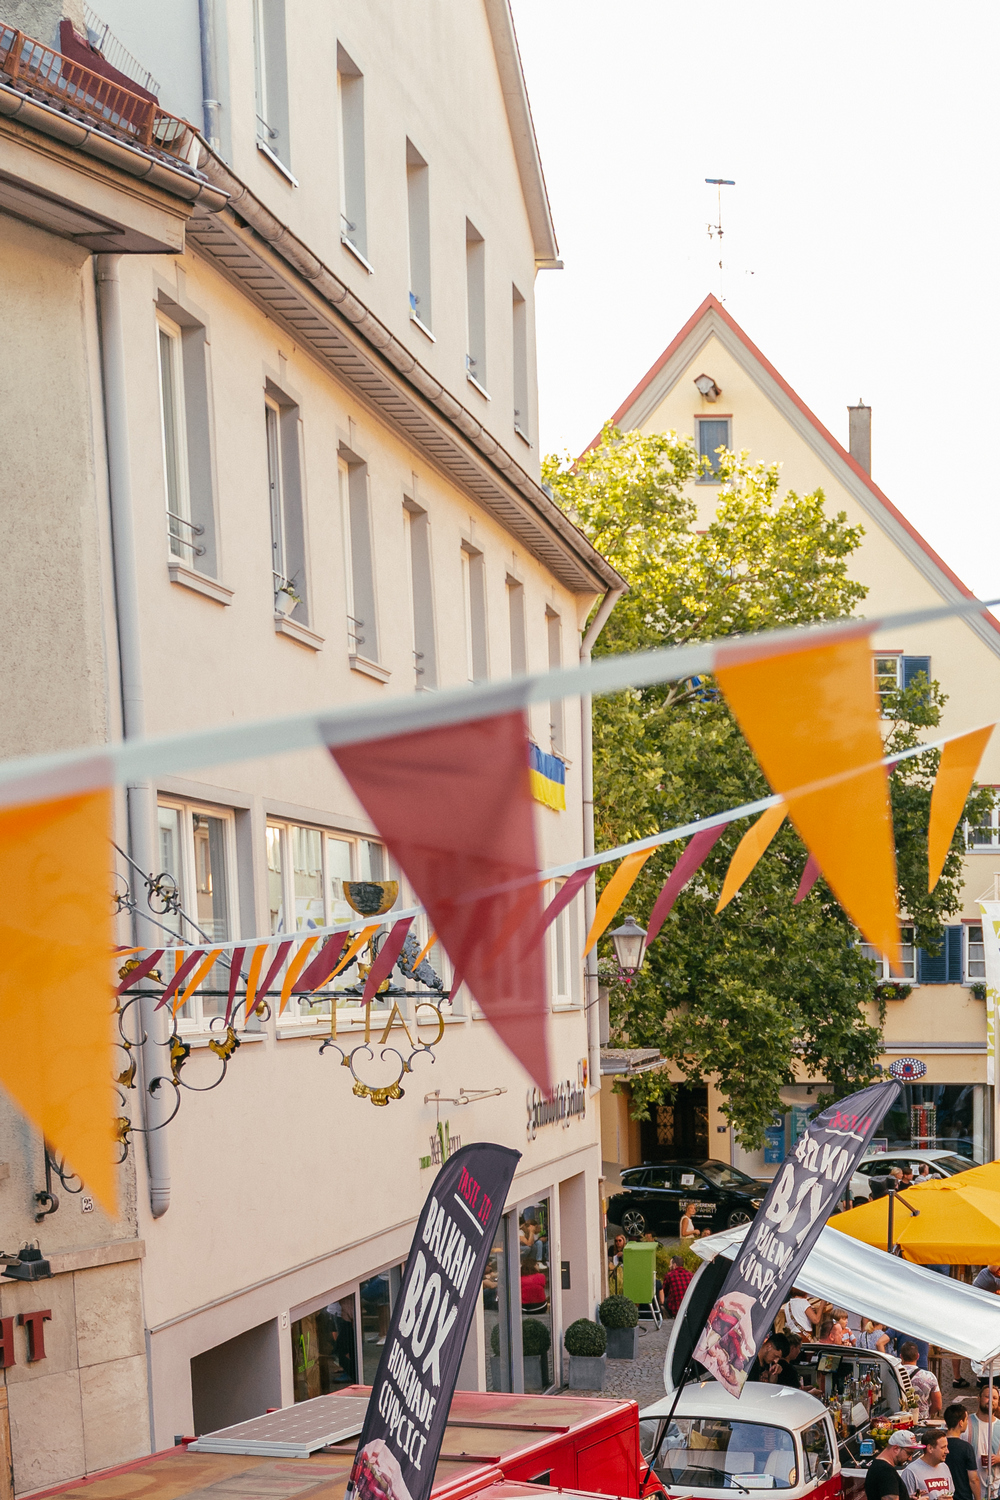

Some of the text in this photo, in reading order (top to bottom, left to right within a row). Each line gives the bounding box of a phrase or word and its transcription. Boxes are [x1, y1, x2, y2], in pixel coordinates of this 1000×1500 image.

[83, 1197, 93, 1212] 25
[457, 1166, 493, 1226] TASTE IT!
[422, 1196, 477, 1299] BALKAN
[399, 1250, 459, 1387] BOX
[387, 1338, 437, 1432] HOMEMADE
